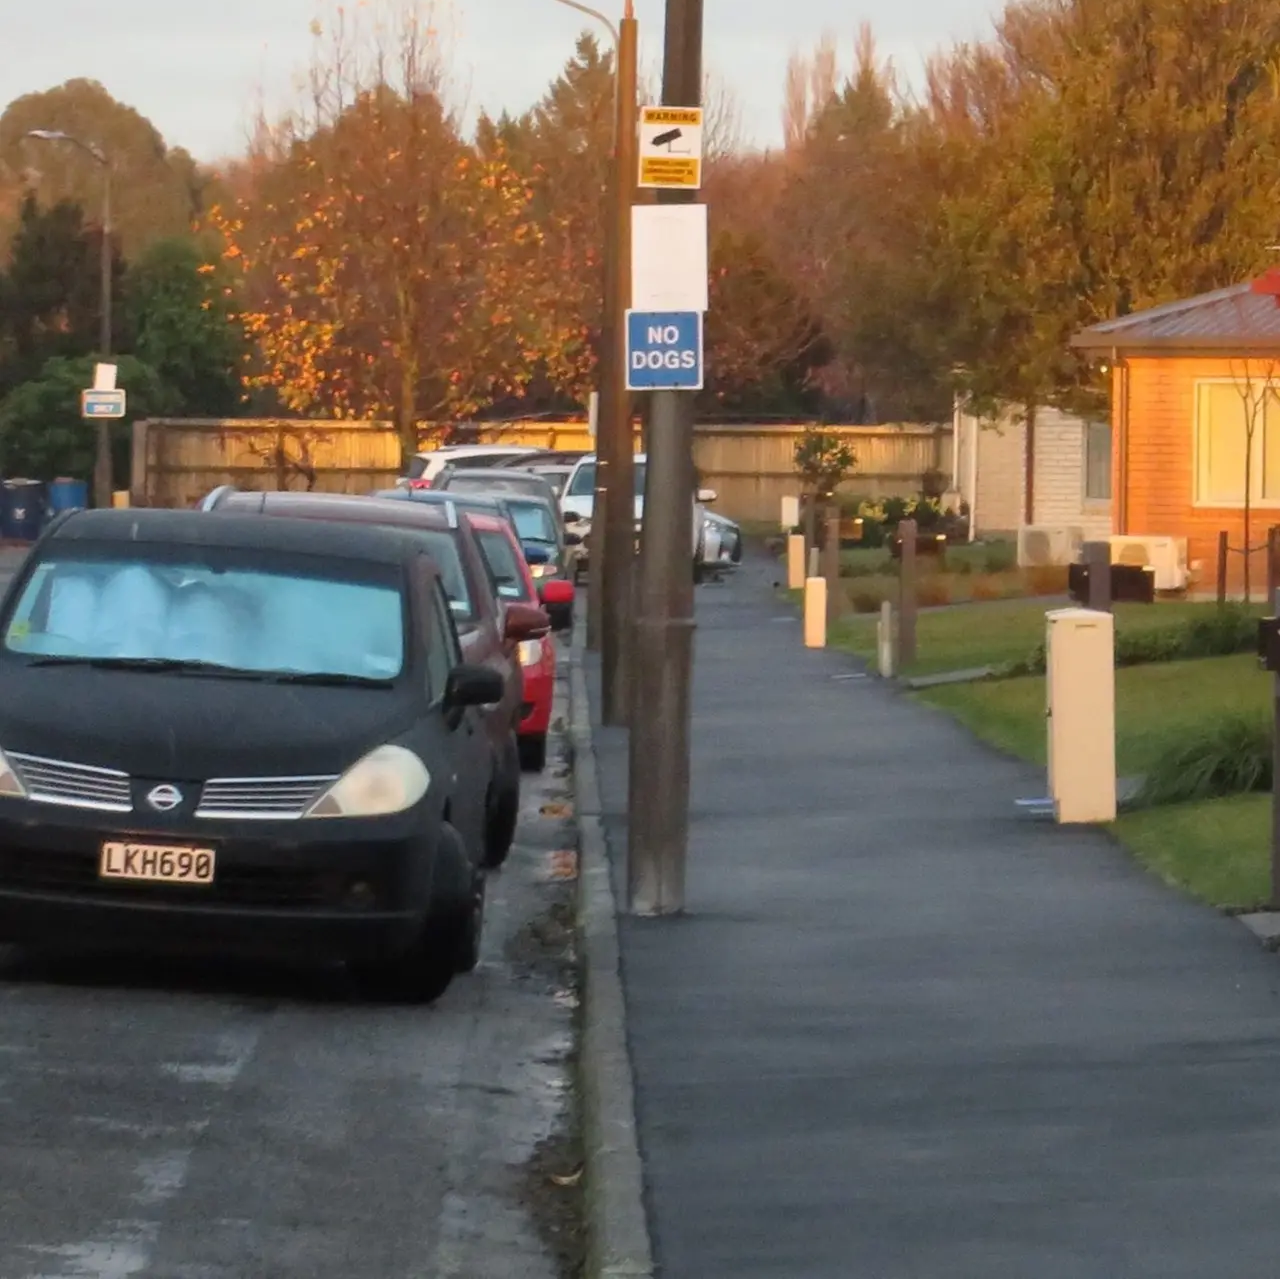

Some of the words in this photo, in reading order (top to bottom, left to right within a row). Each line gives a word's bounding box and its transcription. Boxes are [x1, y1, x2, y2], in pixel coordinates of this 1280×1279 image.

[646, 110, 697, 123] WARNING
[647, 325, 680, 345] NO
[631, 350, 696, 370] DOGS
[105, 847, 212, 879] LKH690
